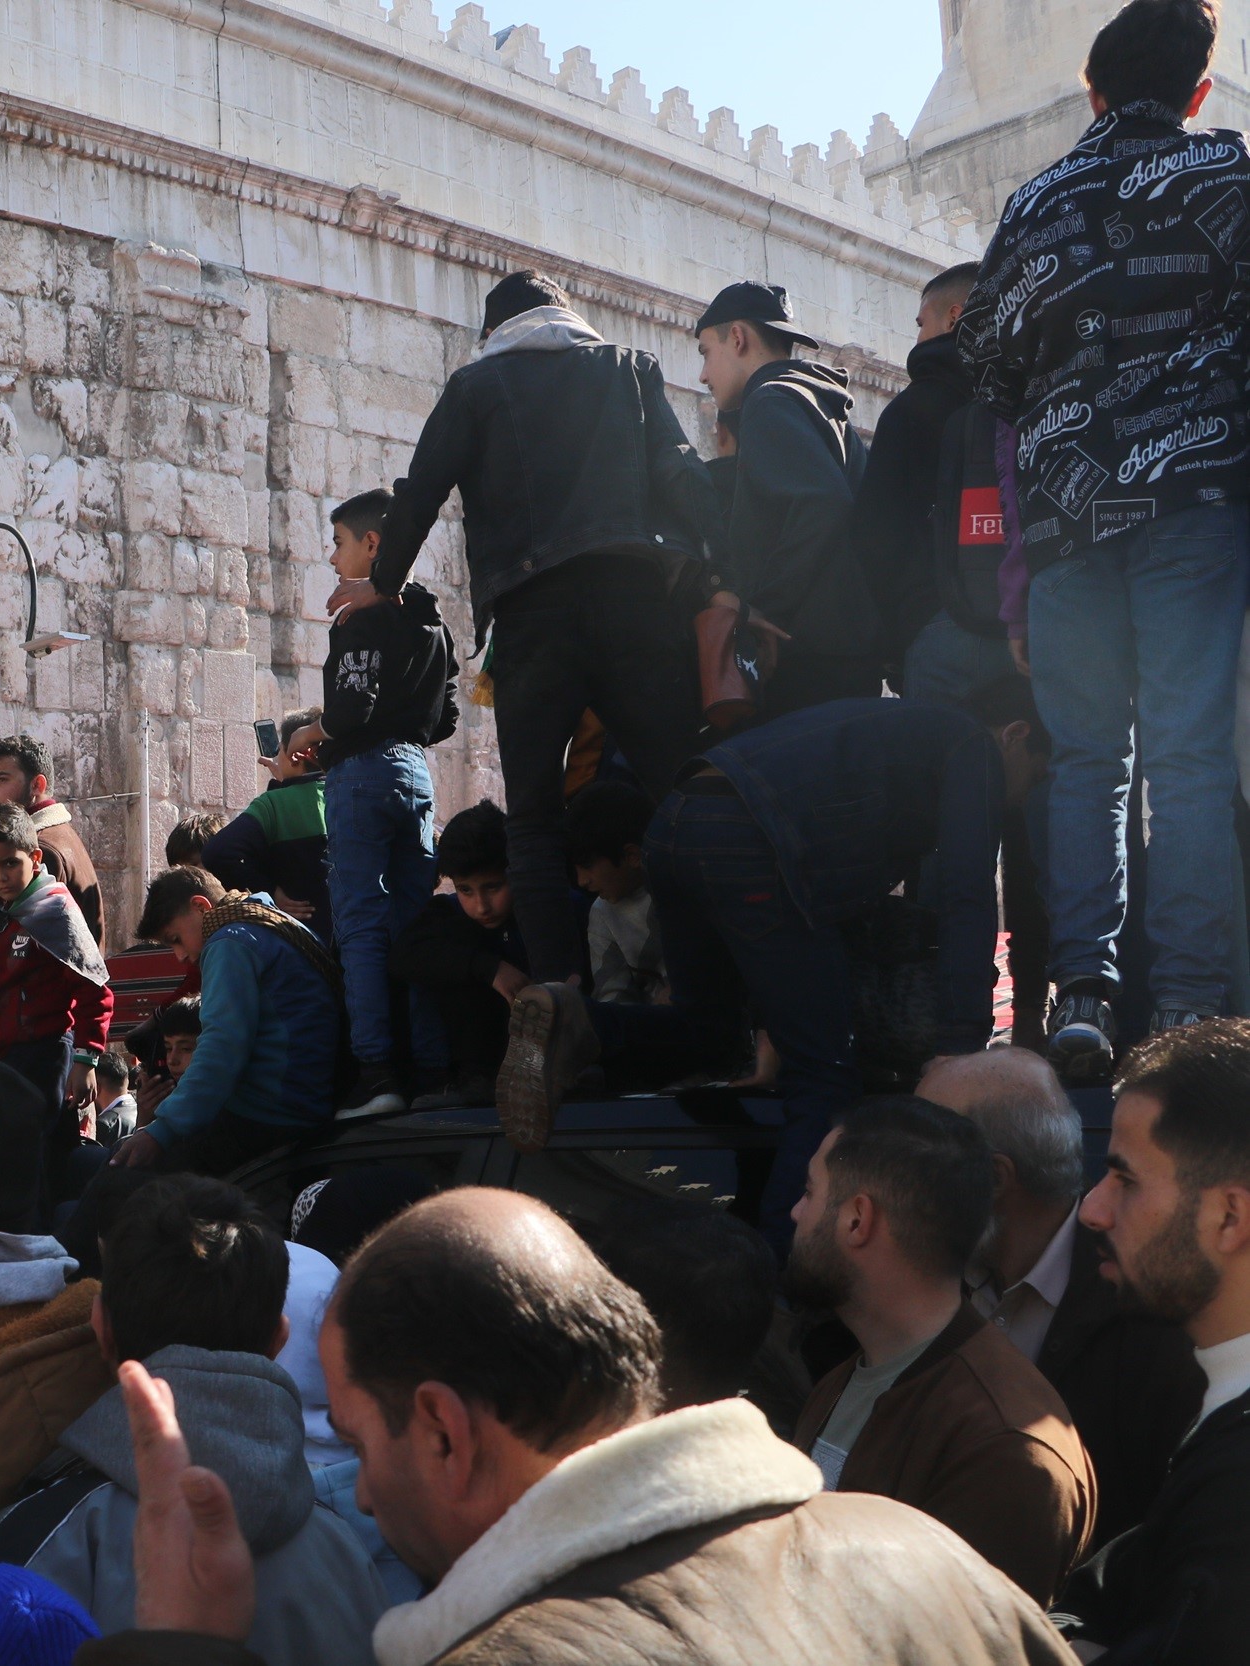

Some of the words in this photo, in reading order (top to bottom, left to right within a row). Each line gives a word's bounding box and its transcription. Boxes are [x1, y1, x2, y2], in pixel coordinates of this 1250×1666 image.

[1114, 138, 1178, 158] PERFEC
[1118, 141, 1239, 200] Adventure
[1204, 179, 1215, 188] in
[1003, 156, 1108, 223] Adventure
[1059, 191, 1068, 199] in
[1070, 180, 1107, 195] contact
[1103, 211, 1134, 249] 5
[1146, 220, 1161, 232] On
[1127, 254, 1209, 276] UNKNOWN
[1111, 308, 1191, 338] UNKNOWN
[1118, 355, 1145, 369] march
[1017, 402, 1091, 472] Adventure
[1113, 403, 1183, 440] PERFECT
[1117, 416, 1229, 484] Adventure
[1050, 472, 1065, 493] SINCE
[1064, 456, 1079, 473] 1987
[1060, 461, 1089, 507] Adventure
[1174, 462, 1201, 474] march
[1070, 496, 1080, 511] THE
[1078, 477, 1094, 498] SPIRIT
[1091, 468, 1101, 479] OF
[1099, 513, 1122, 521] SINCE
[1126, 511, 1146, 520] 1987
